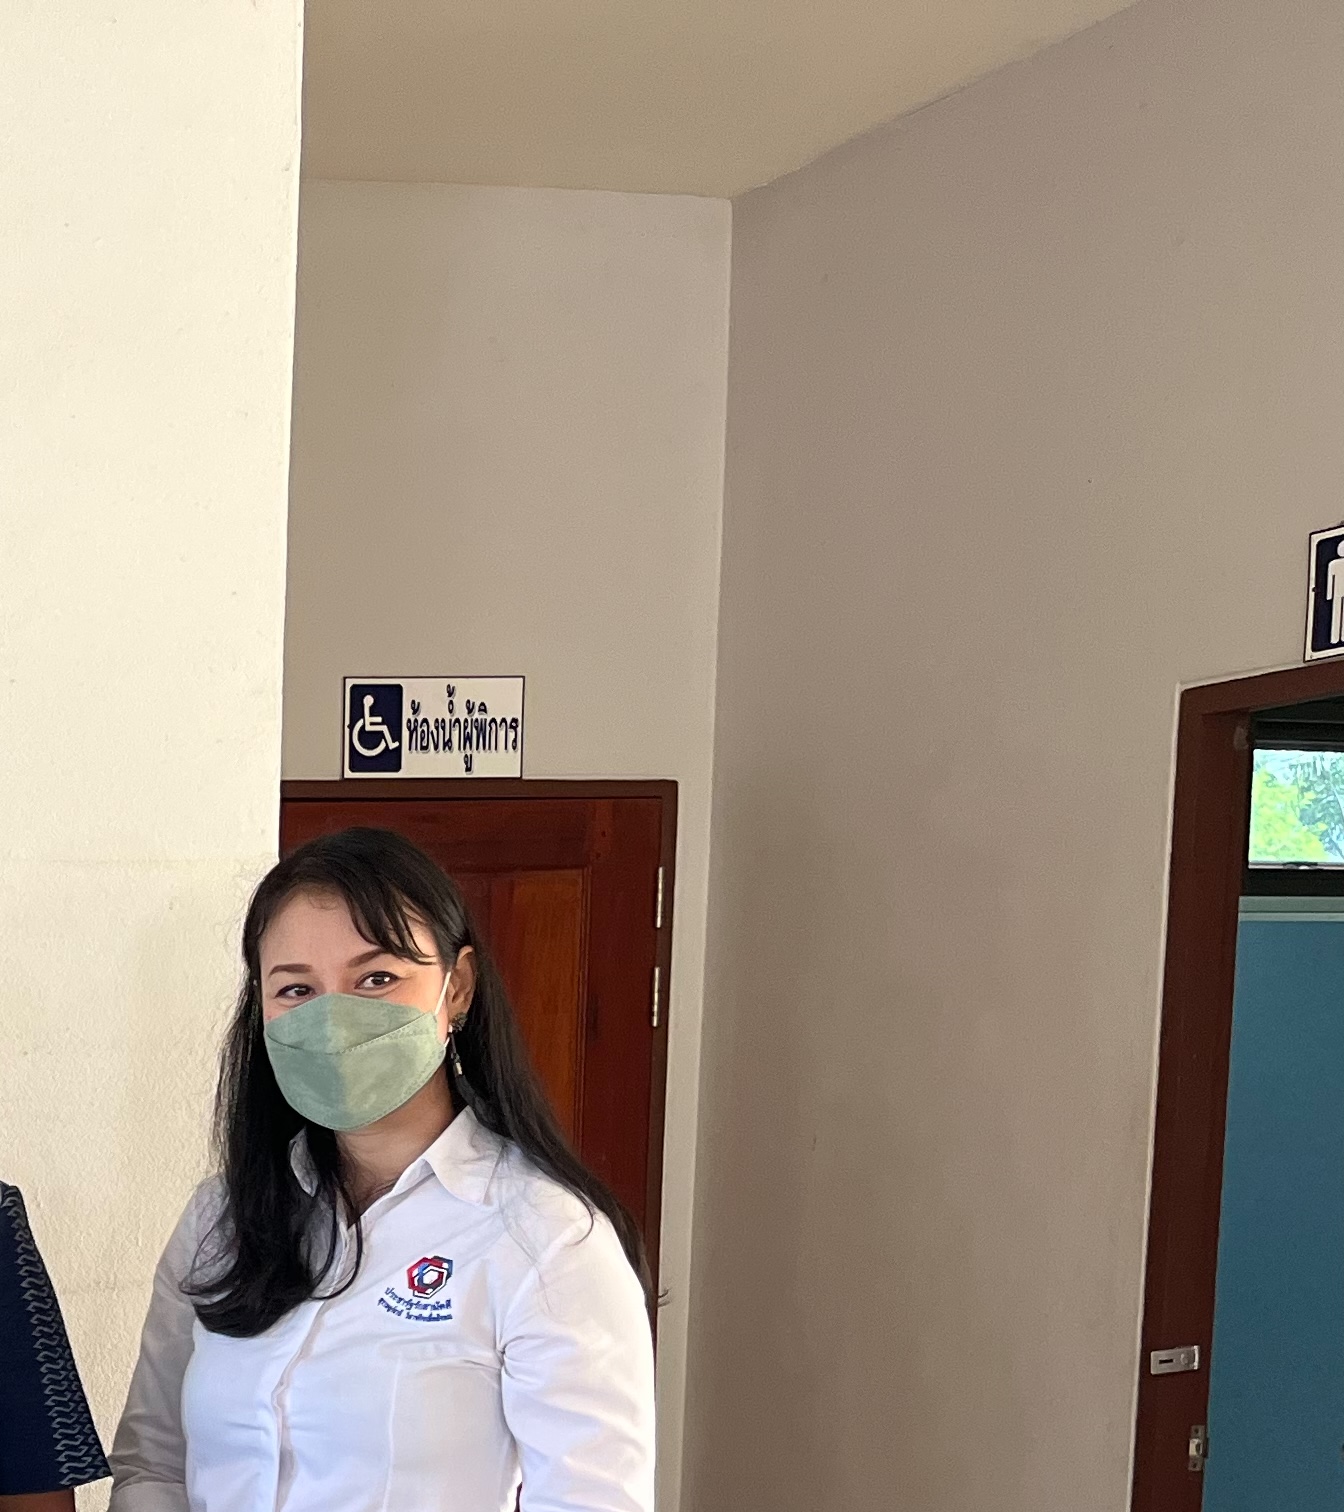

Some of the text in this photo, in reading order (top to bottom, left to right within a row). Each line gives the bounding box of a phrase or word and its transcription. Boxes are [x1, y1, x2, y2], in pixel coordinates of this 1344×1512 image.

[406, 684, 519, 773] ห้องน้ำผู้พิการ
